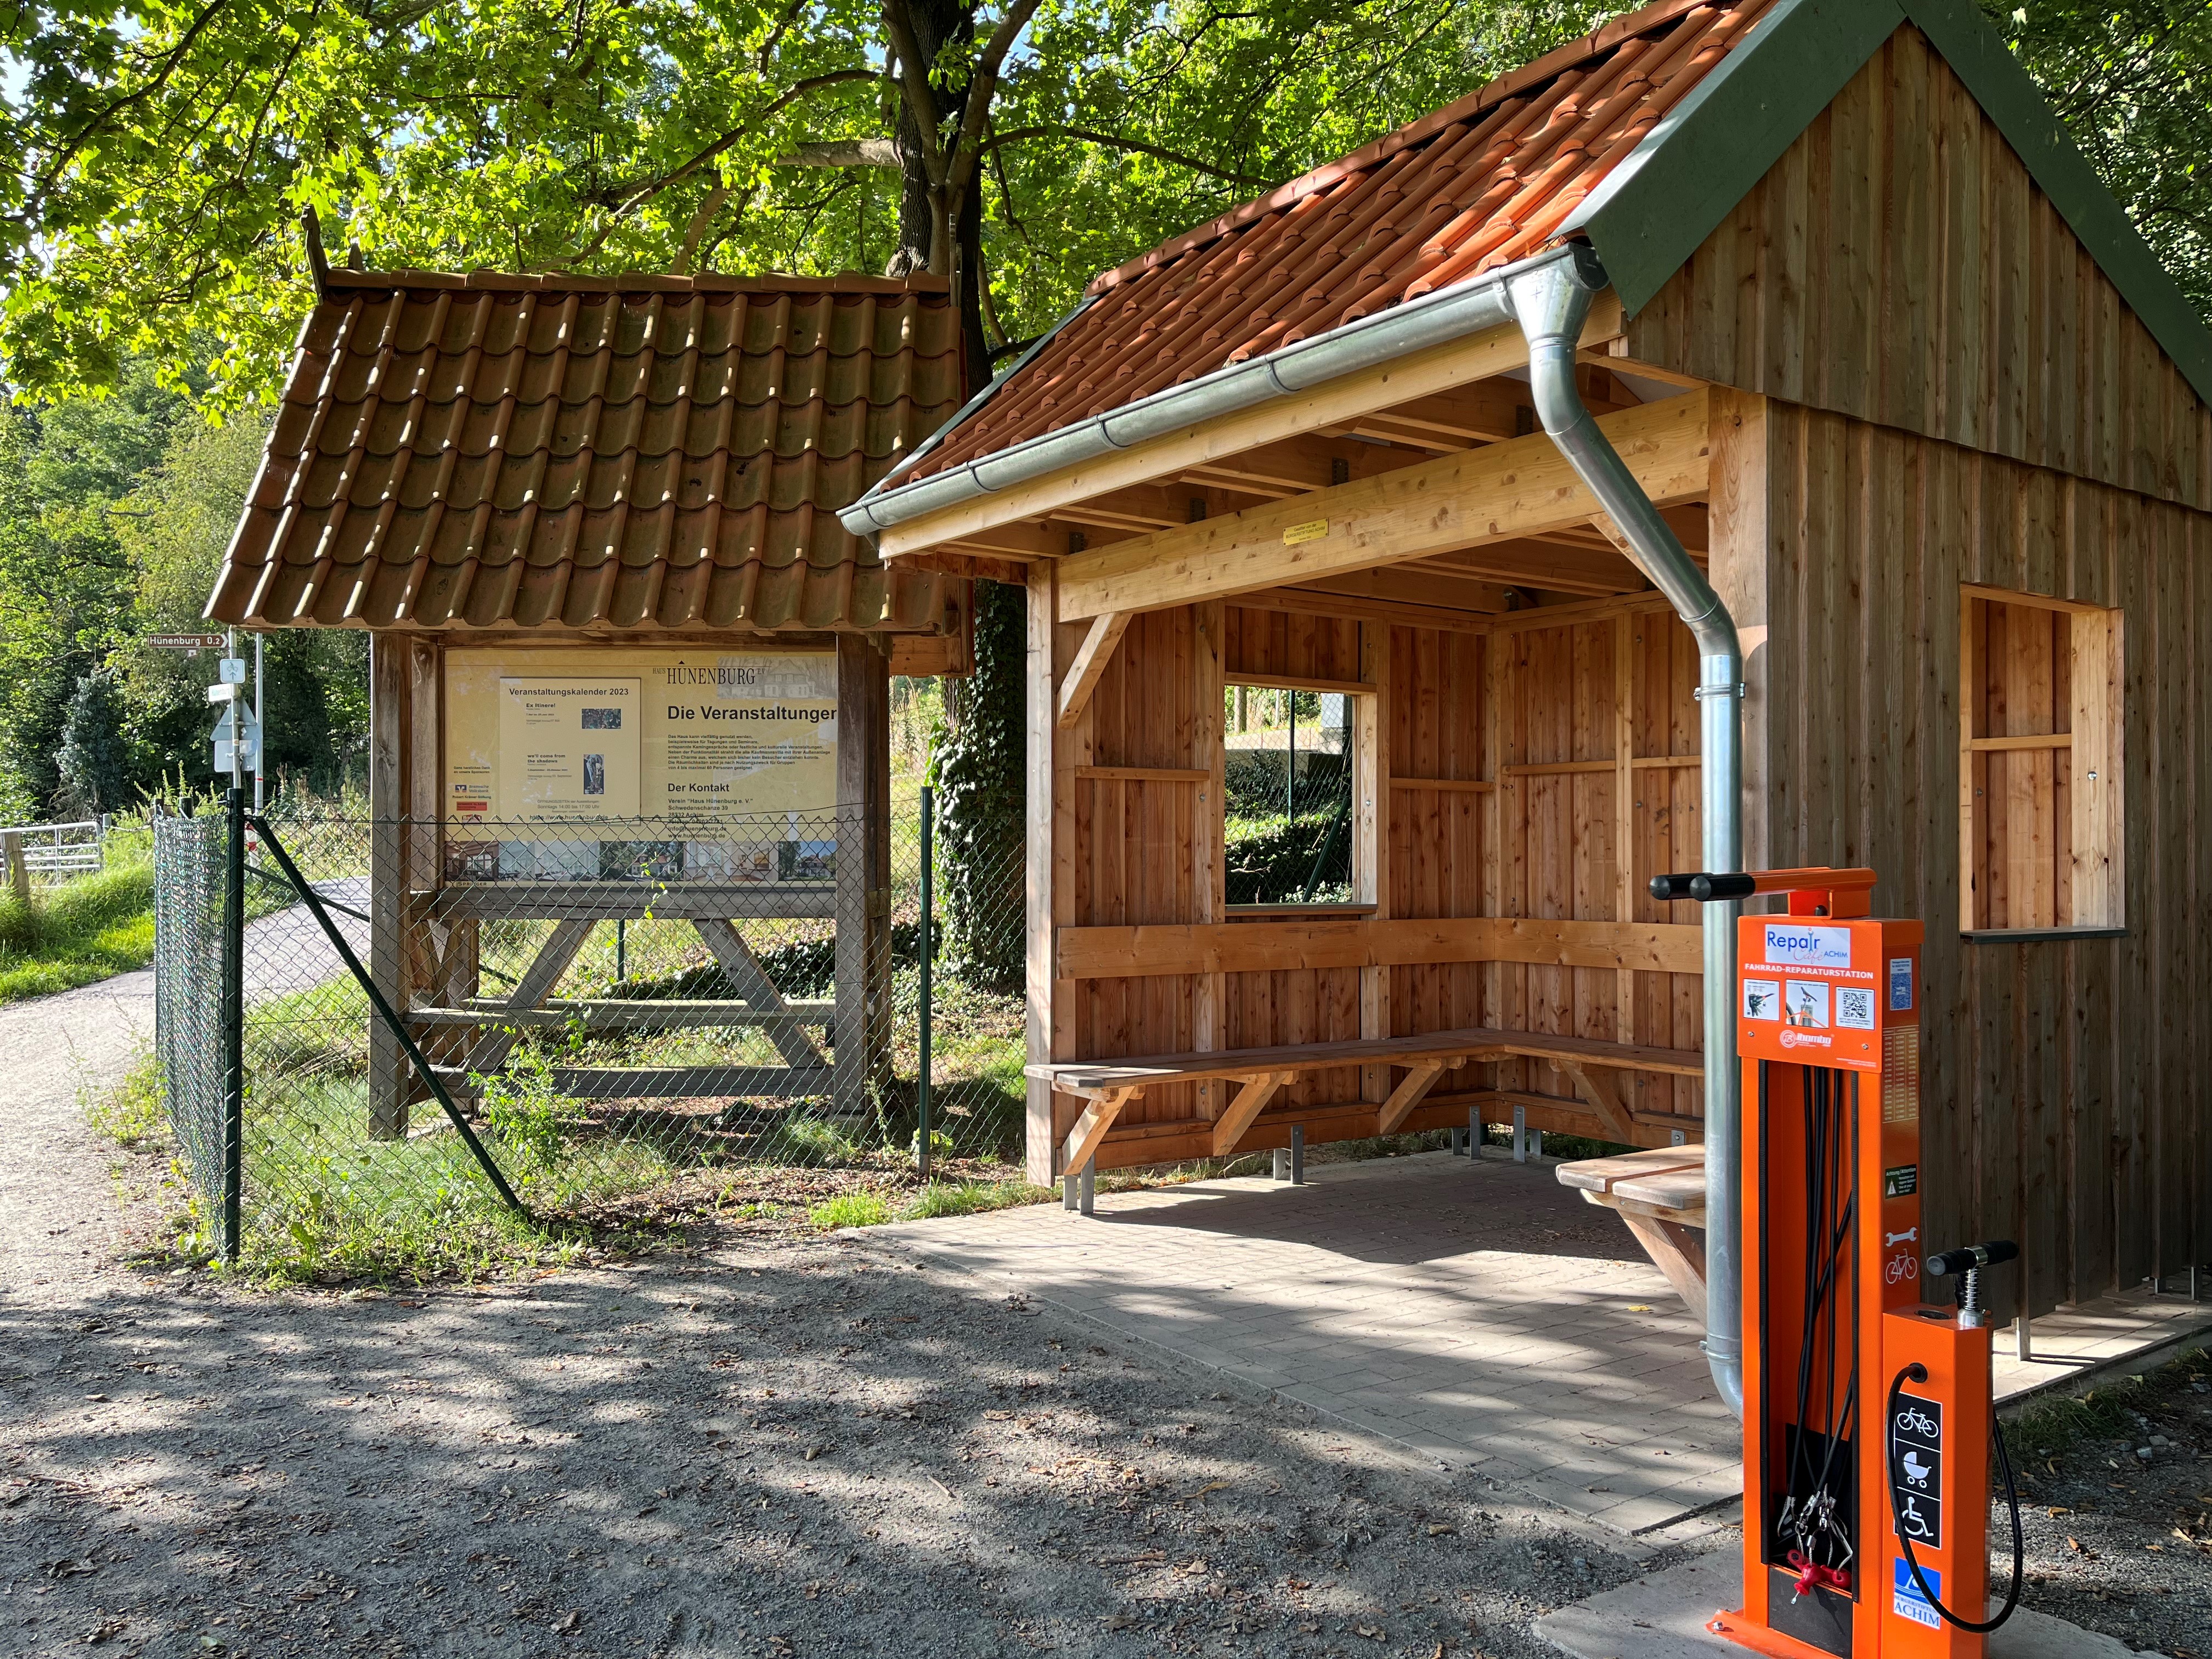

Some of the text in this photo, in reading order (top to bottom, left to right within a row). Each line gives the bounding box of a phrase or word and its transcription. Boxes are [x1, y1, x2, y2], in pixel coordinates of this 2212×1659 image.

[150, 636, 201, 646] Hünenburg
[509, 688, 607, 697] Veranstaltungskalender
[668, 706, 695, 720] Die
[668, 783, 730, 792] Der Kontakt
[1824, 950, 1848, 958] ACHIM
[1745, 963, 1874, 979] FAHRRAD-REPARATURSTATION
[1894, 1595, 1939, 1615] BÜRGERSTIFTUN
[1895, 1601, 1940, 1627] ACHIM
